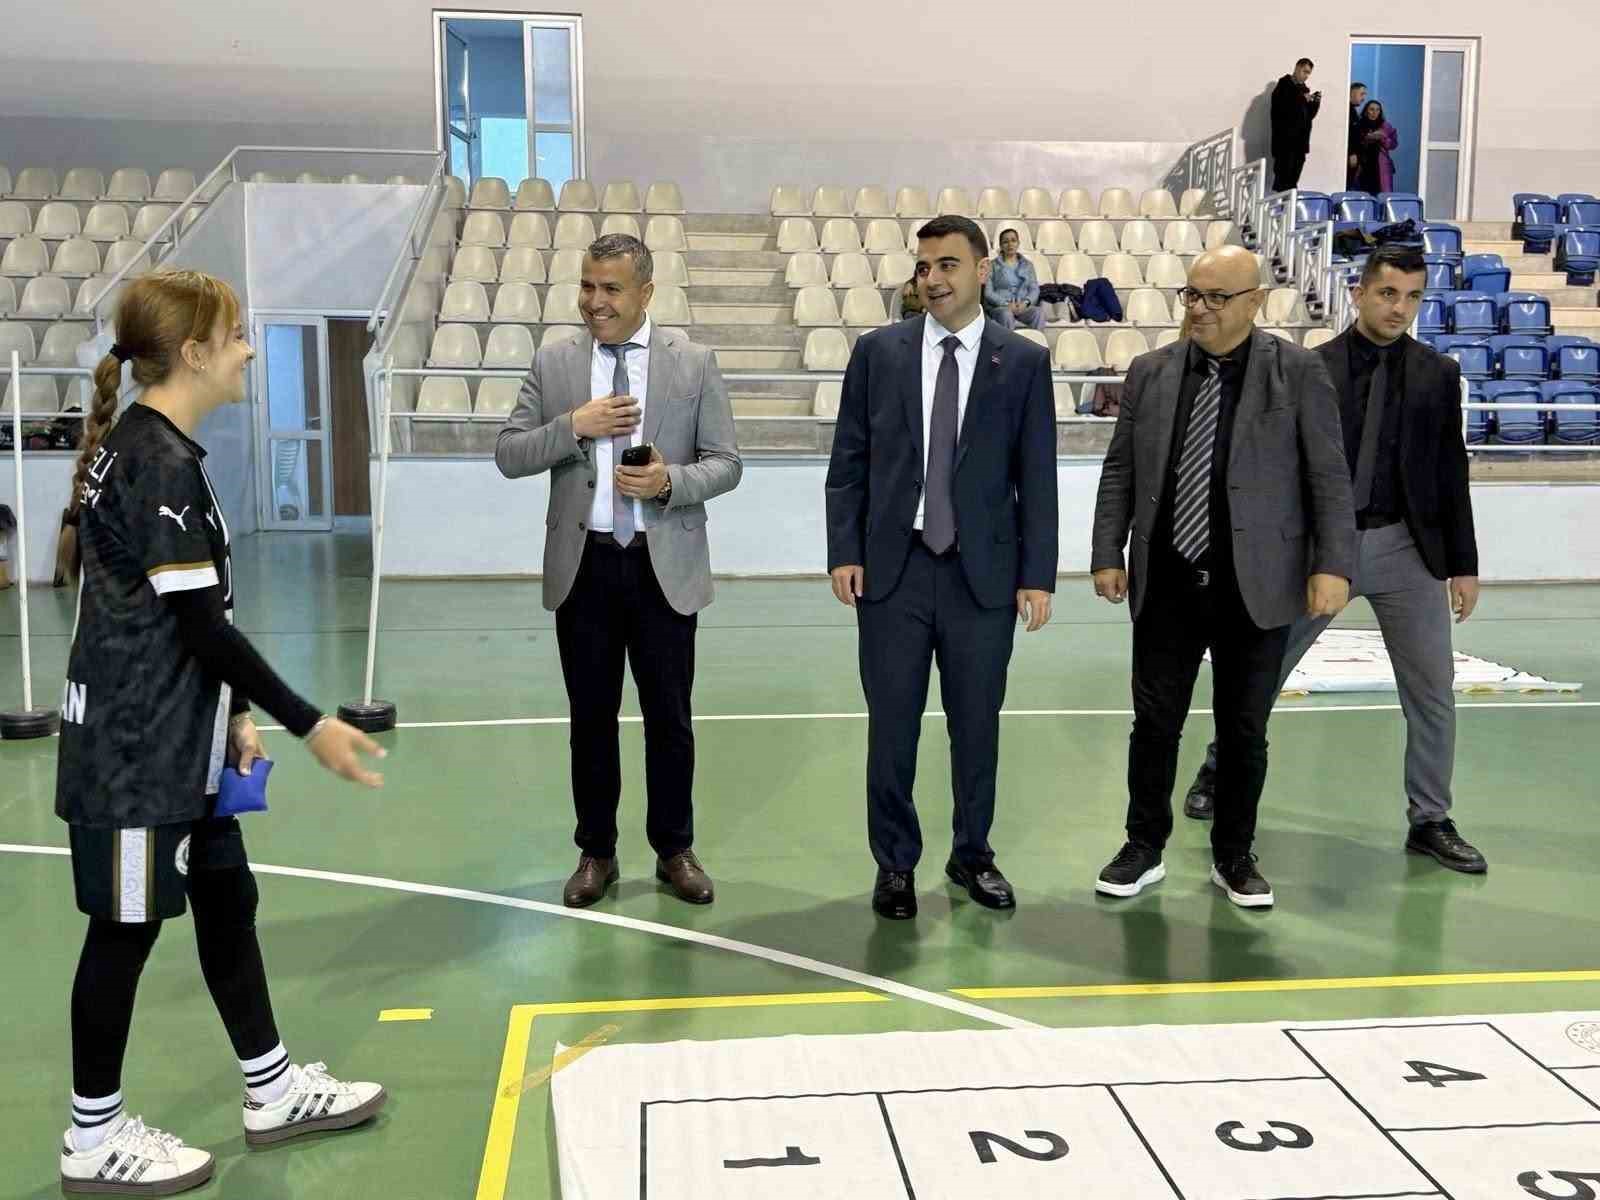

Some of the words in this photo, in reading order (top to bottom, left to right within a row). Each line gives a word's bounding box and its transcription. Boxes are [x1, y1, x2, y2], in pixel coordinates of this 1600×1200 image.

[1403, 1061, 1488, 1088] 4
[969, 1130, 1069, 1164] 2
[1215, 1120, 1314, 1152] 3
[723, 1146, 821, 1169] 1
